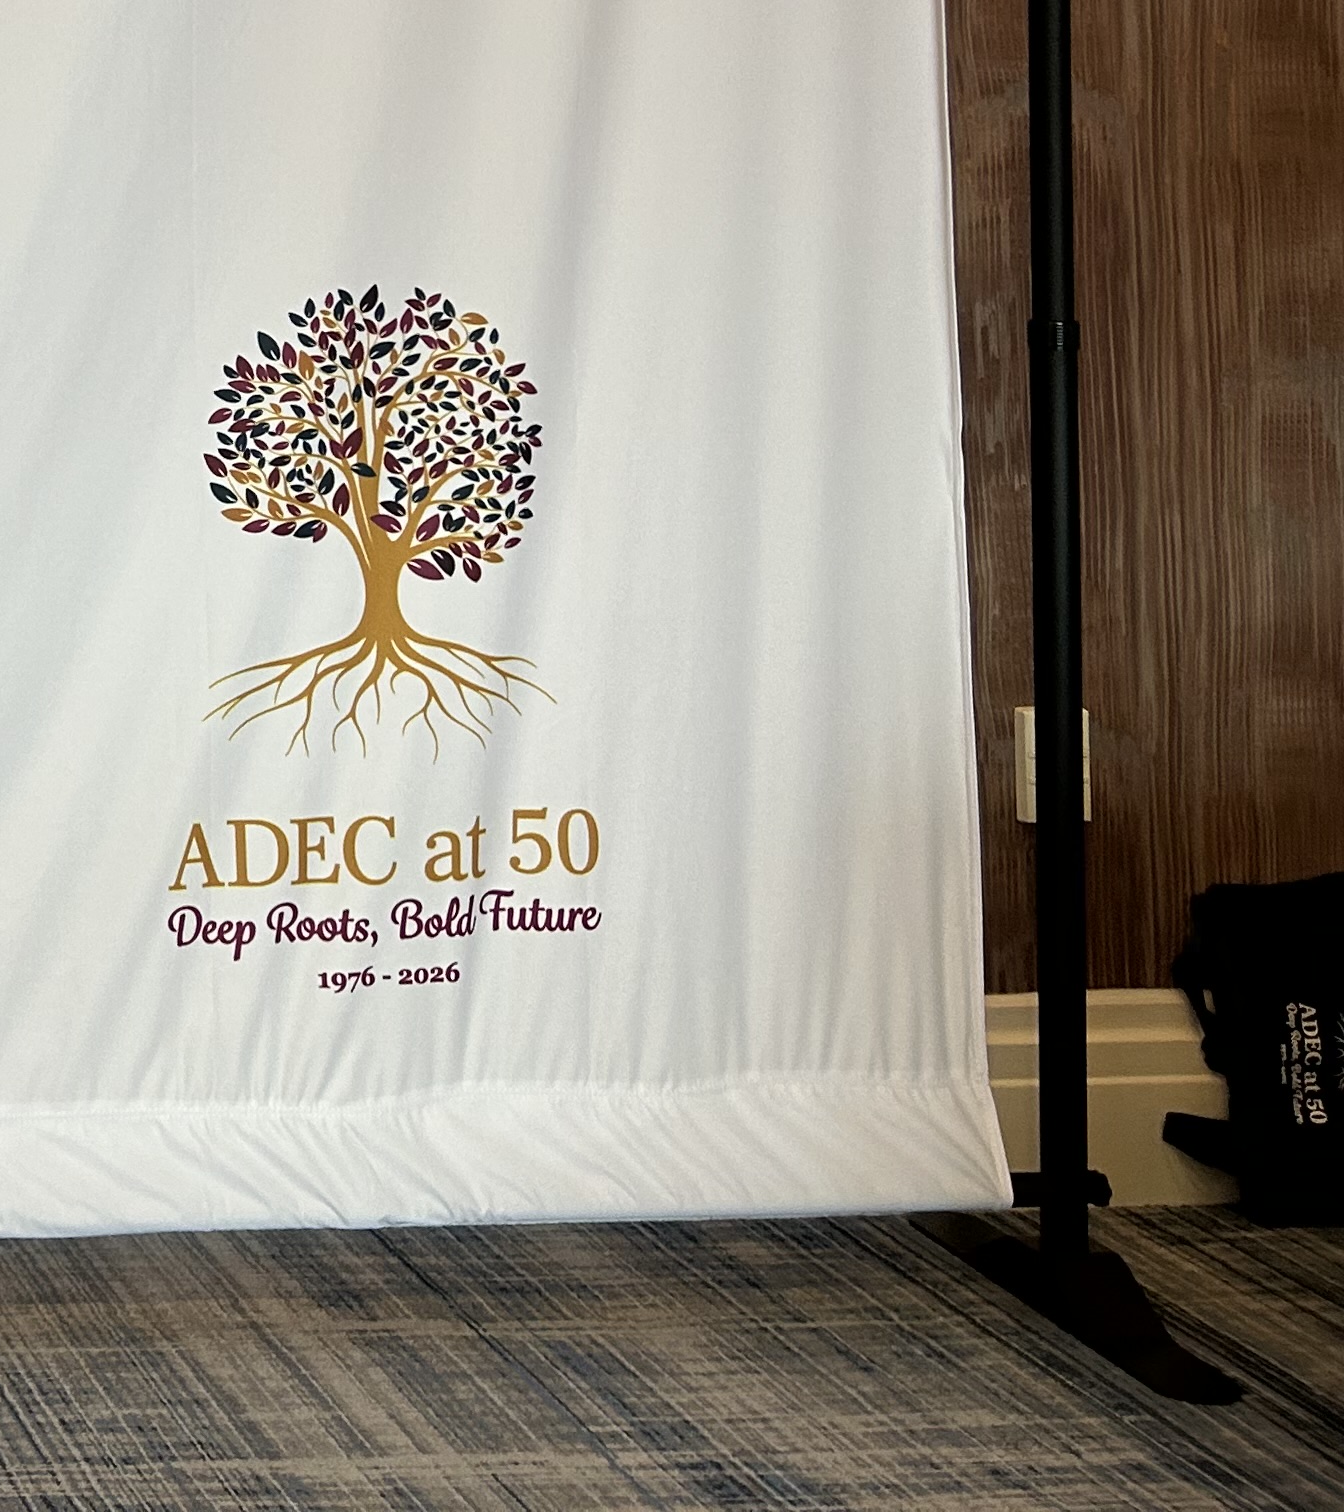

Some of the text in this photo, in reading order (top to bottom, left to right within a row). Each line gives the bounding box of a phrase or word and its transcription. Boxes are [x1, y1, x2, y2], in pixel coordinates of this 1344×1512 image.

[168, 807, 599, 891] ADEC at 50
[168, 890, 602, 961] Deep Roots, Bold Future
[318, 966, 375, 993] 1976
[399, 962, 460, 985] 2026
[1299, 1003, 1328, 1124] ADEC at 50
